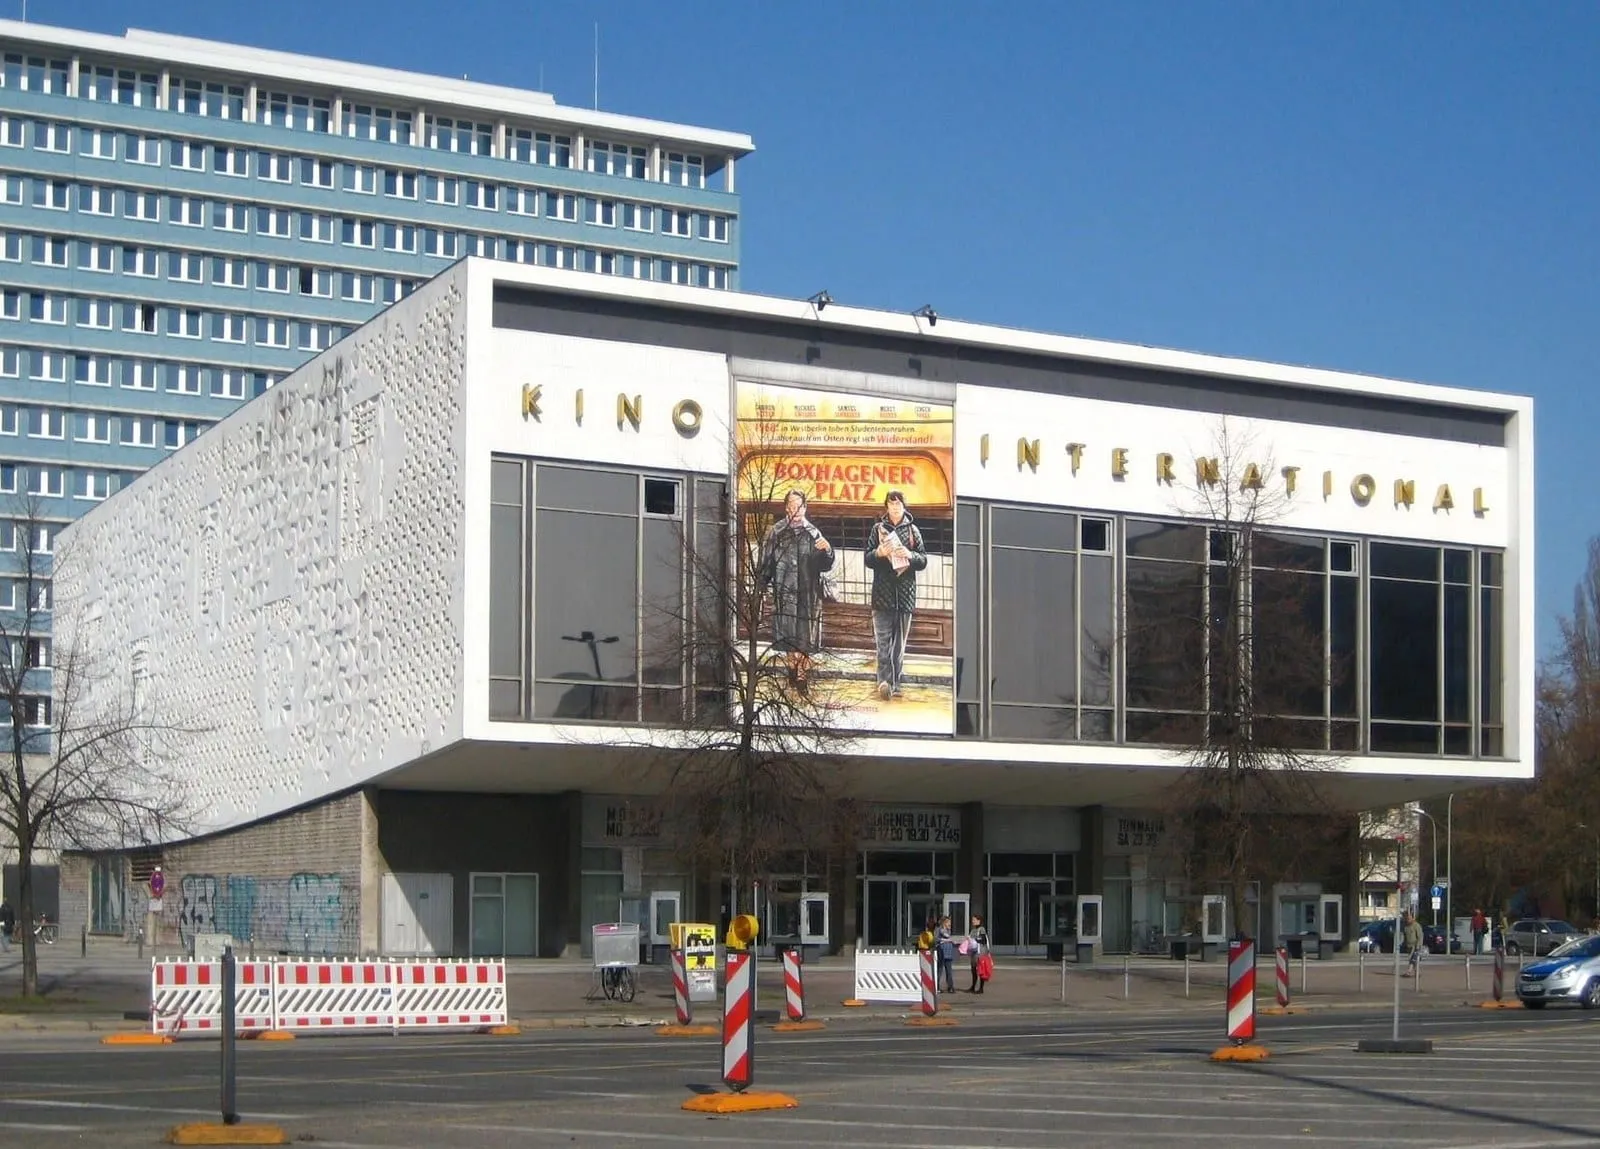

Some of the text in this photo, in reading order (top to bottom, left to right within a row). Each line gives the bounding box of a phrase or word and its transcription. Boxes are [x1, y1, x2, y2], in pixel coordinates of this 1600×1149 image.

[522, 383, 703, 435] KINO
[790, 424, 827, 433] Westberlin
[828, 425, 849, 433] toben
[849, 425, 916, 433] Studentenunruhen
[823, 434, 845, 443] Osten
[876, 434, 934, 445] Widerstand!
[775, 462, 917, 485] BOXHAGENER
[979, 433, 1490, 516] INTERNATIONAL
[815, 482, 877, 501] PLATZ
[917, 812, 953, 830] PLATZ
